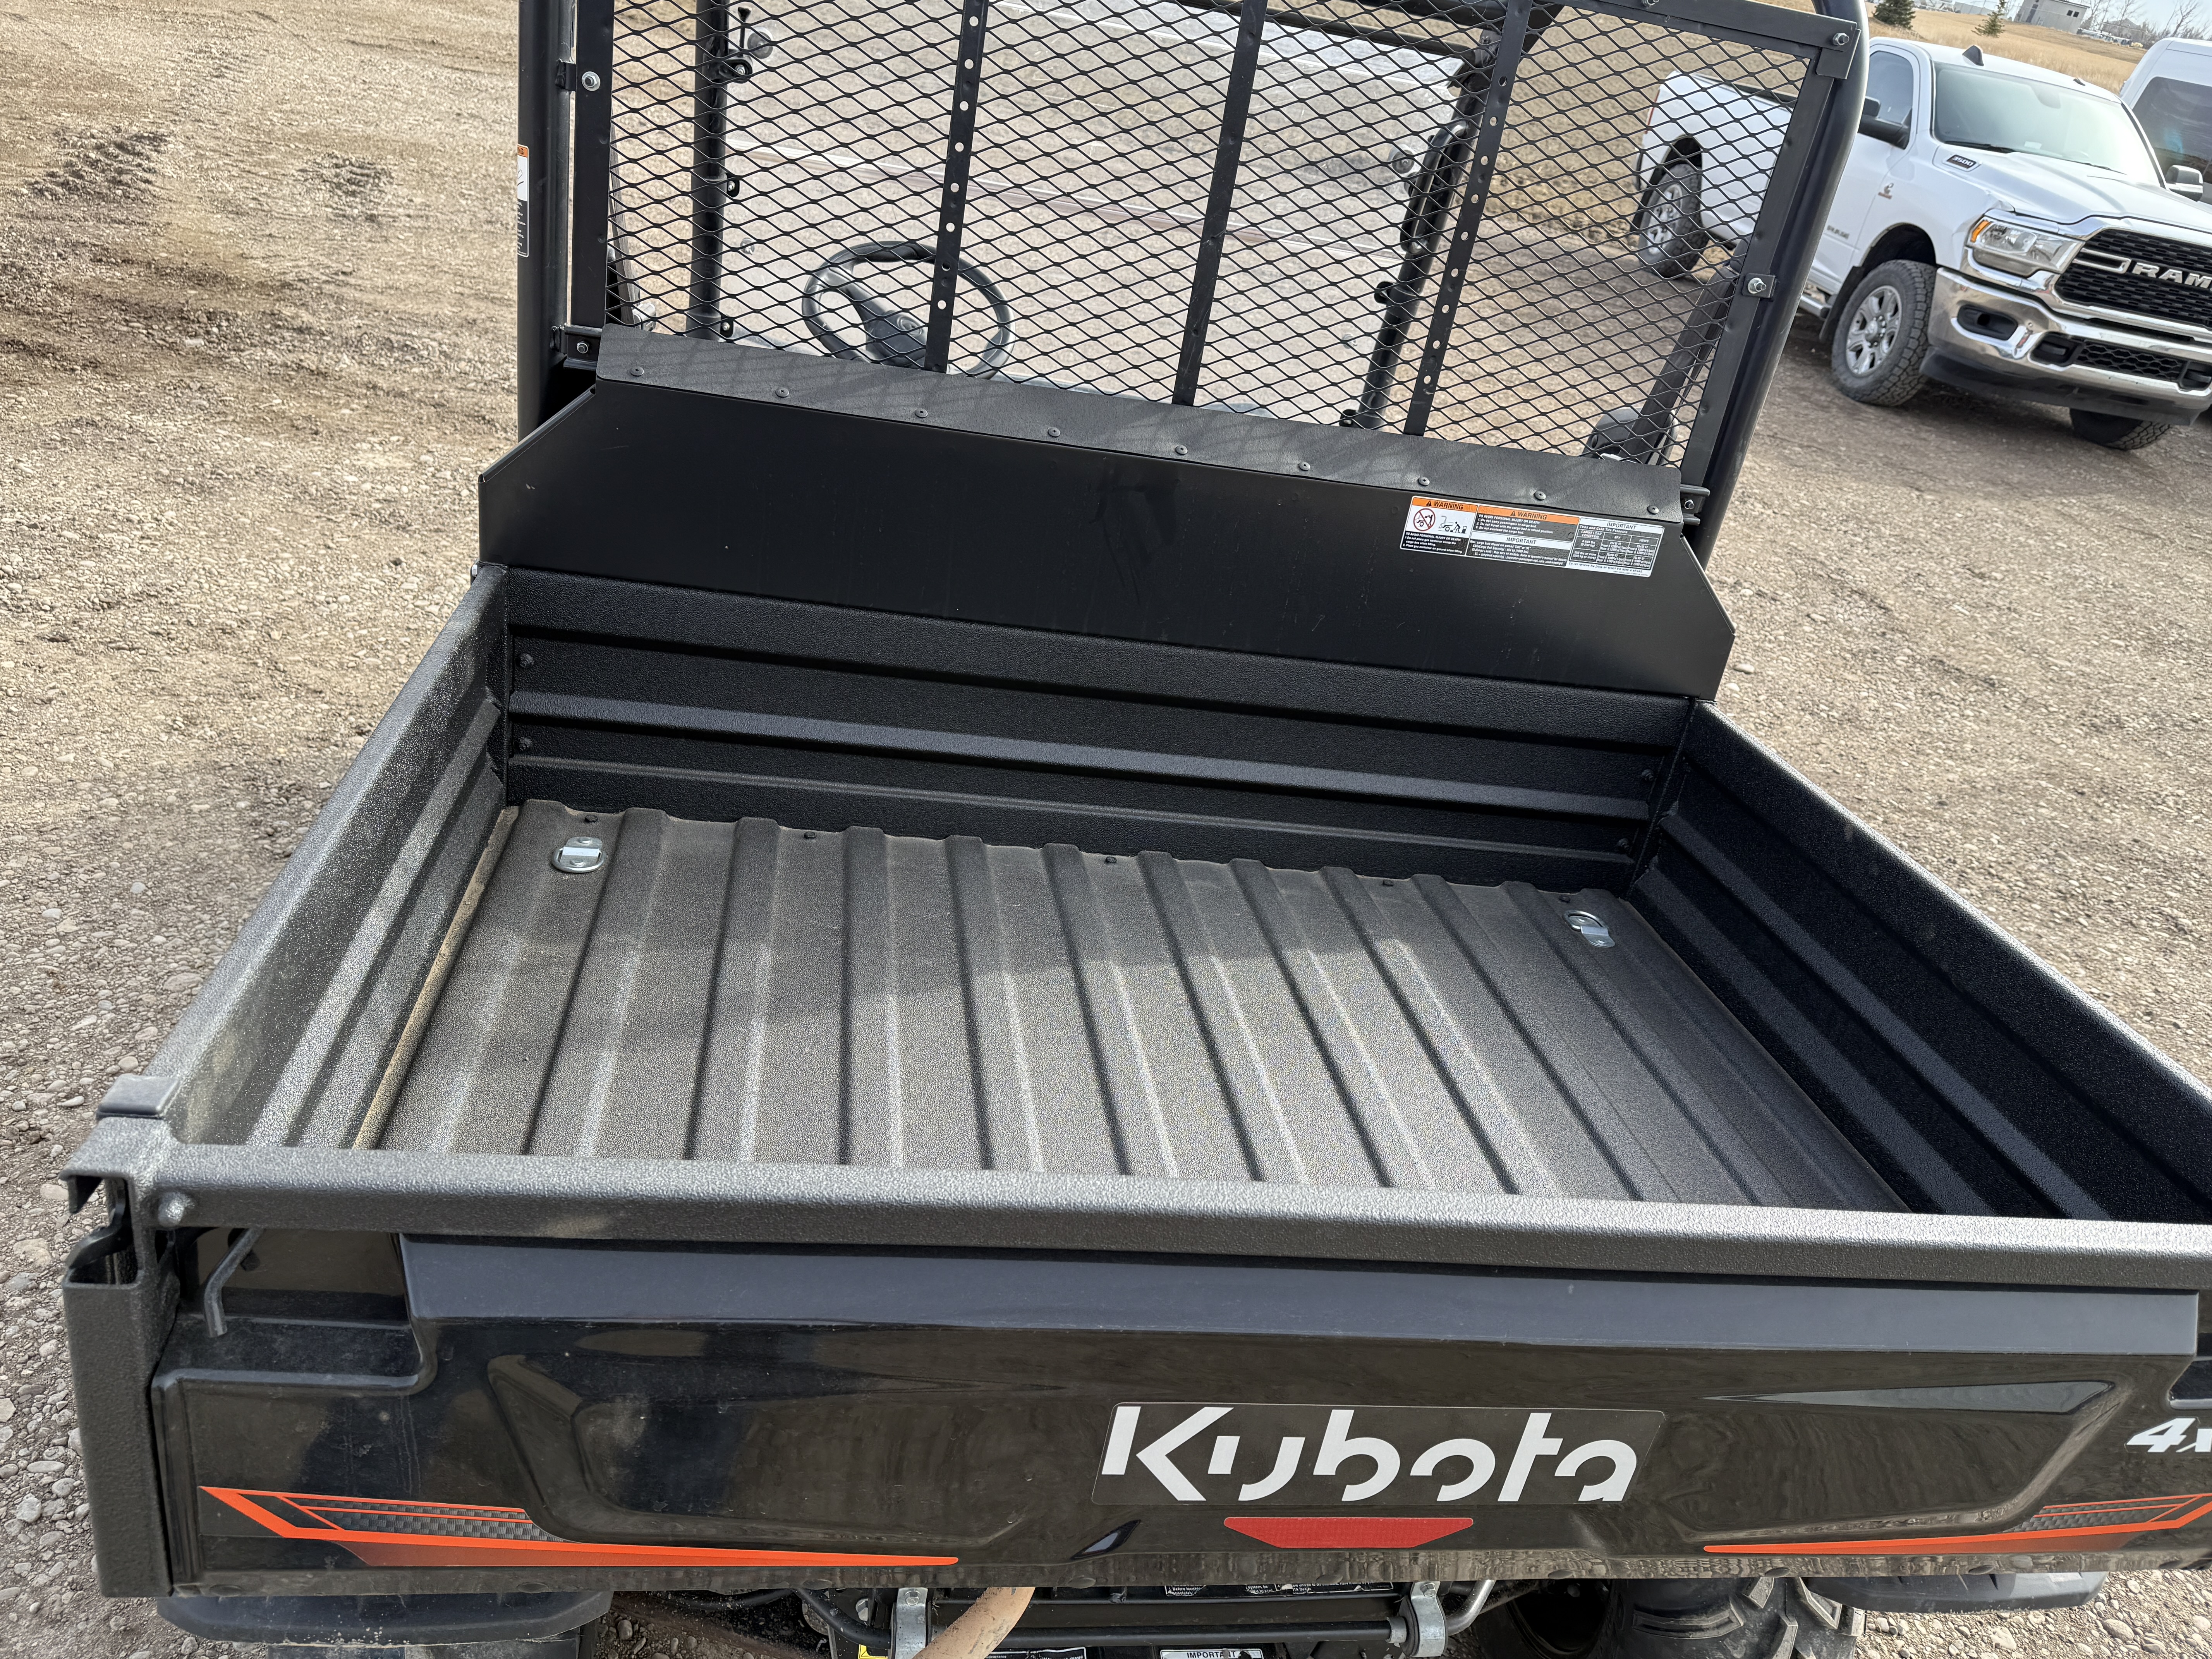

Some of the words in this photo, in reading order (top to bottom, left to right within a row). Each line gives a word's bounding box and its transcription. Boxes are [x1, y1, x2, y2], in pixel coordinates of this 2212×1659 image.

[1952, 156, 1974, 166] 3500
[2132, 262, 2212, 289] RAM
[1434, 501, 1463, 510] WARNING
[1518, 512, 1547, 520] WARNING
[1102, 1406, 1637, 1501] Kubota
